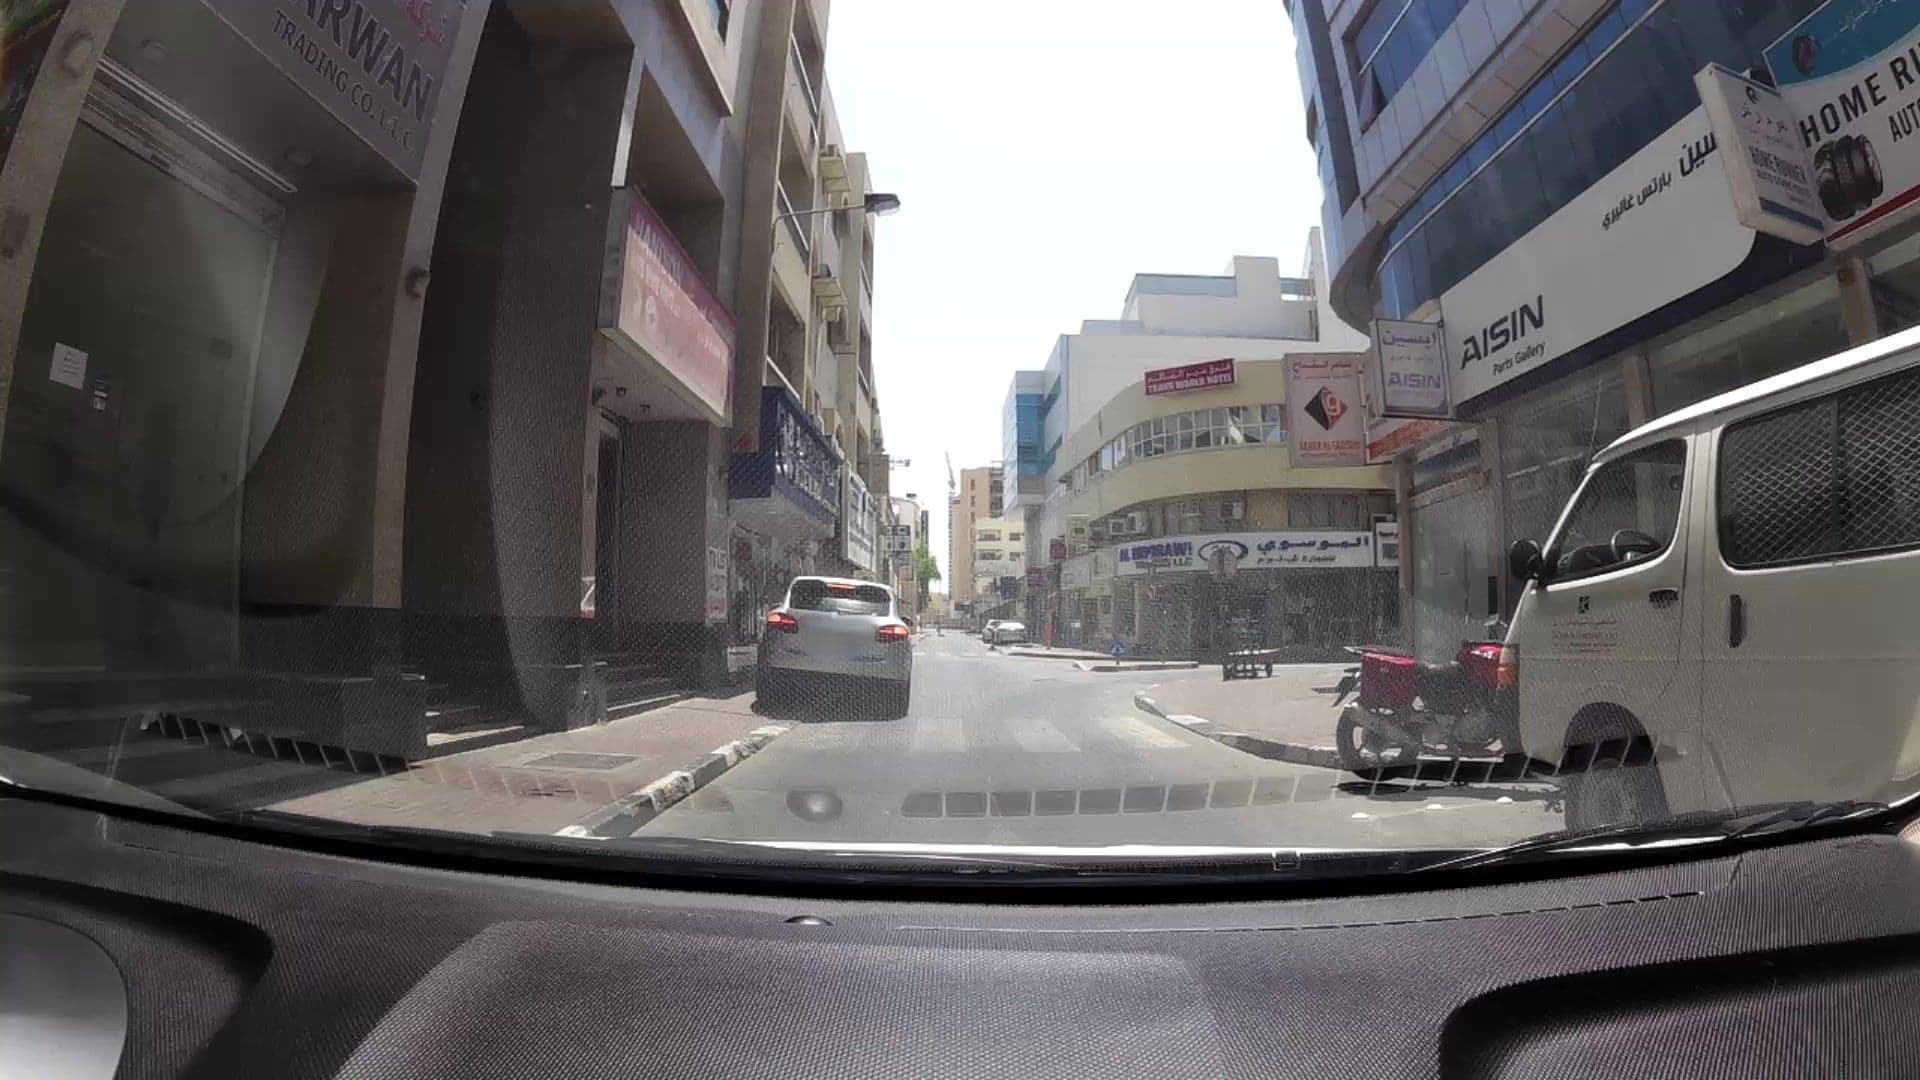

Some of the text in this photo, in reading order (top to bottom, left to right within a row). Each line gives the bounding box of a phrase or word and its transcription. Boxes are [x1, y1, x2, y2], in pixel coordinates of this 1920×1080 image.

[273, 9, 349, 93] TRADING
[351, 84, 375, 119] CO.
[1799, 72, 1888, 148] HOME
[1888, 97, 1920, 143] AUT
[1461, 294, 1544, 370] AISIN
[1389, 372, 1441, 389] AISIN
[1492, 358, 1513, 377] Parts
